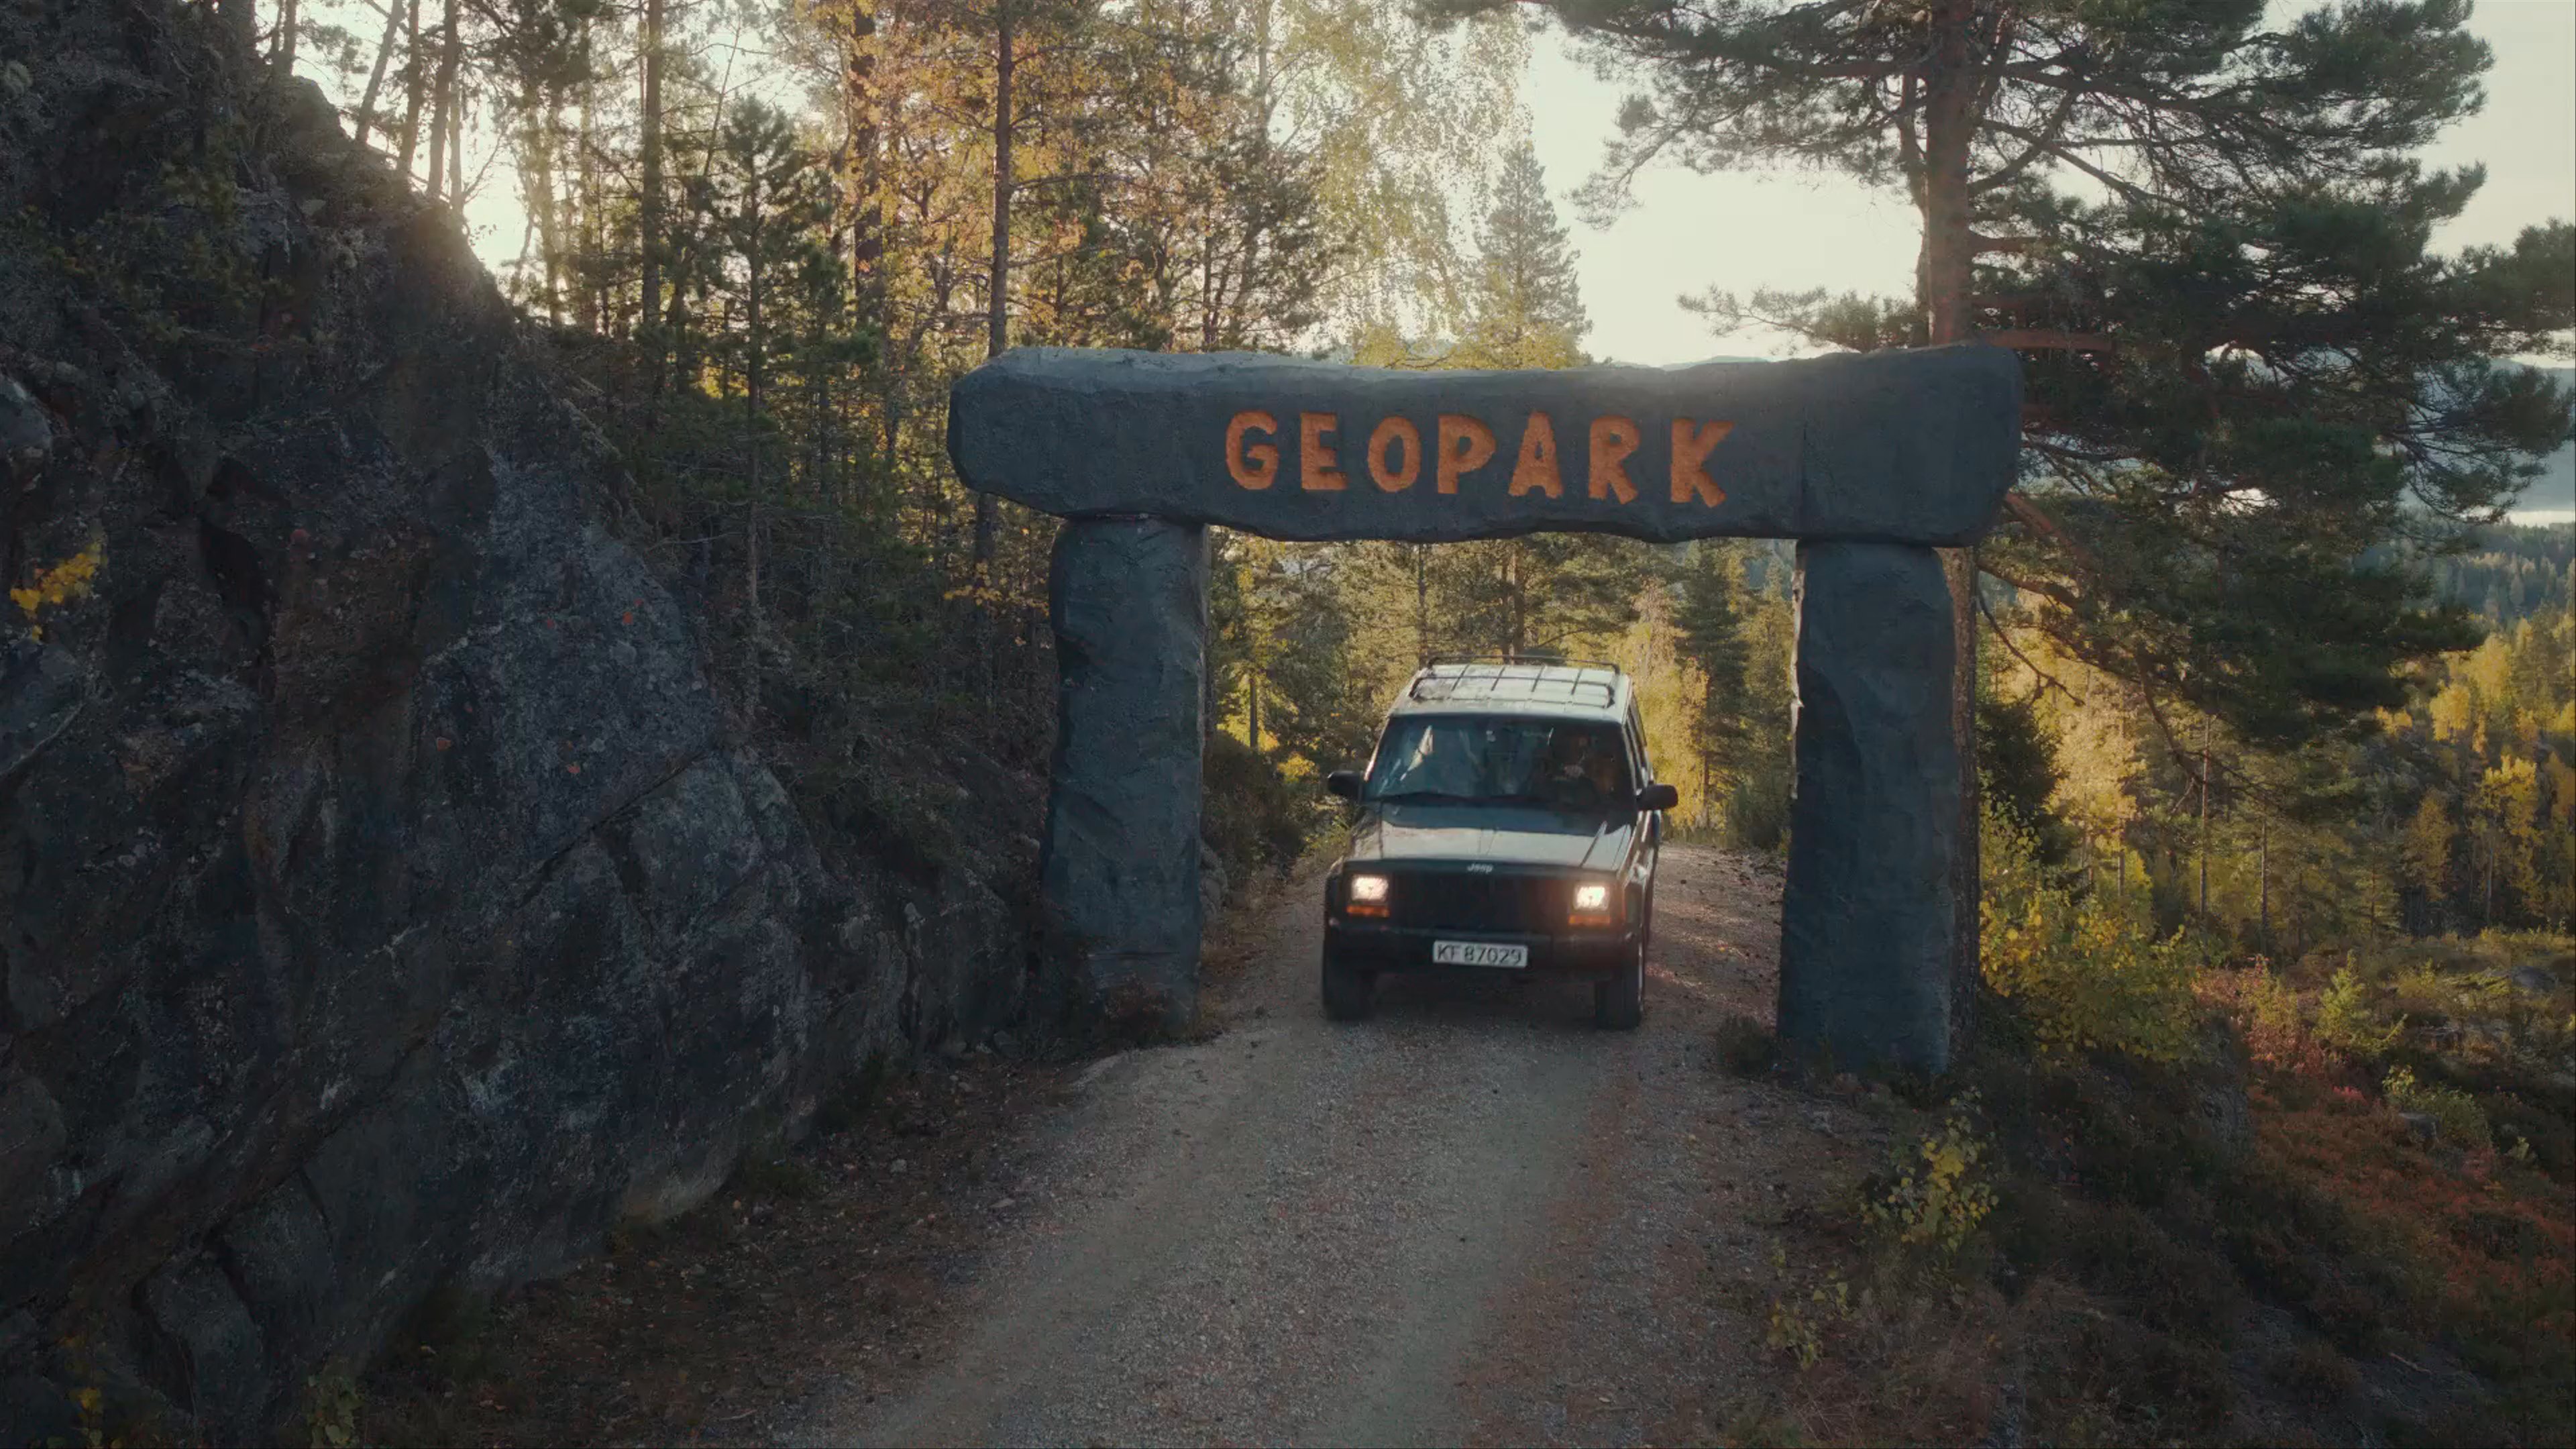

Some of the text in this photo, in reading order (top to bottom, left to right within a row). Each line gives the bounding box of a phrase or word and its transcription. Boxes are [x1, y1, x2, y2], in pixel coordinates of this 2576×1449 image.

[1226, 411, 1732, 506] GEOPARK
[1438, 944, 1521, 966] KF 87029
